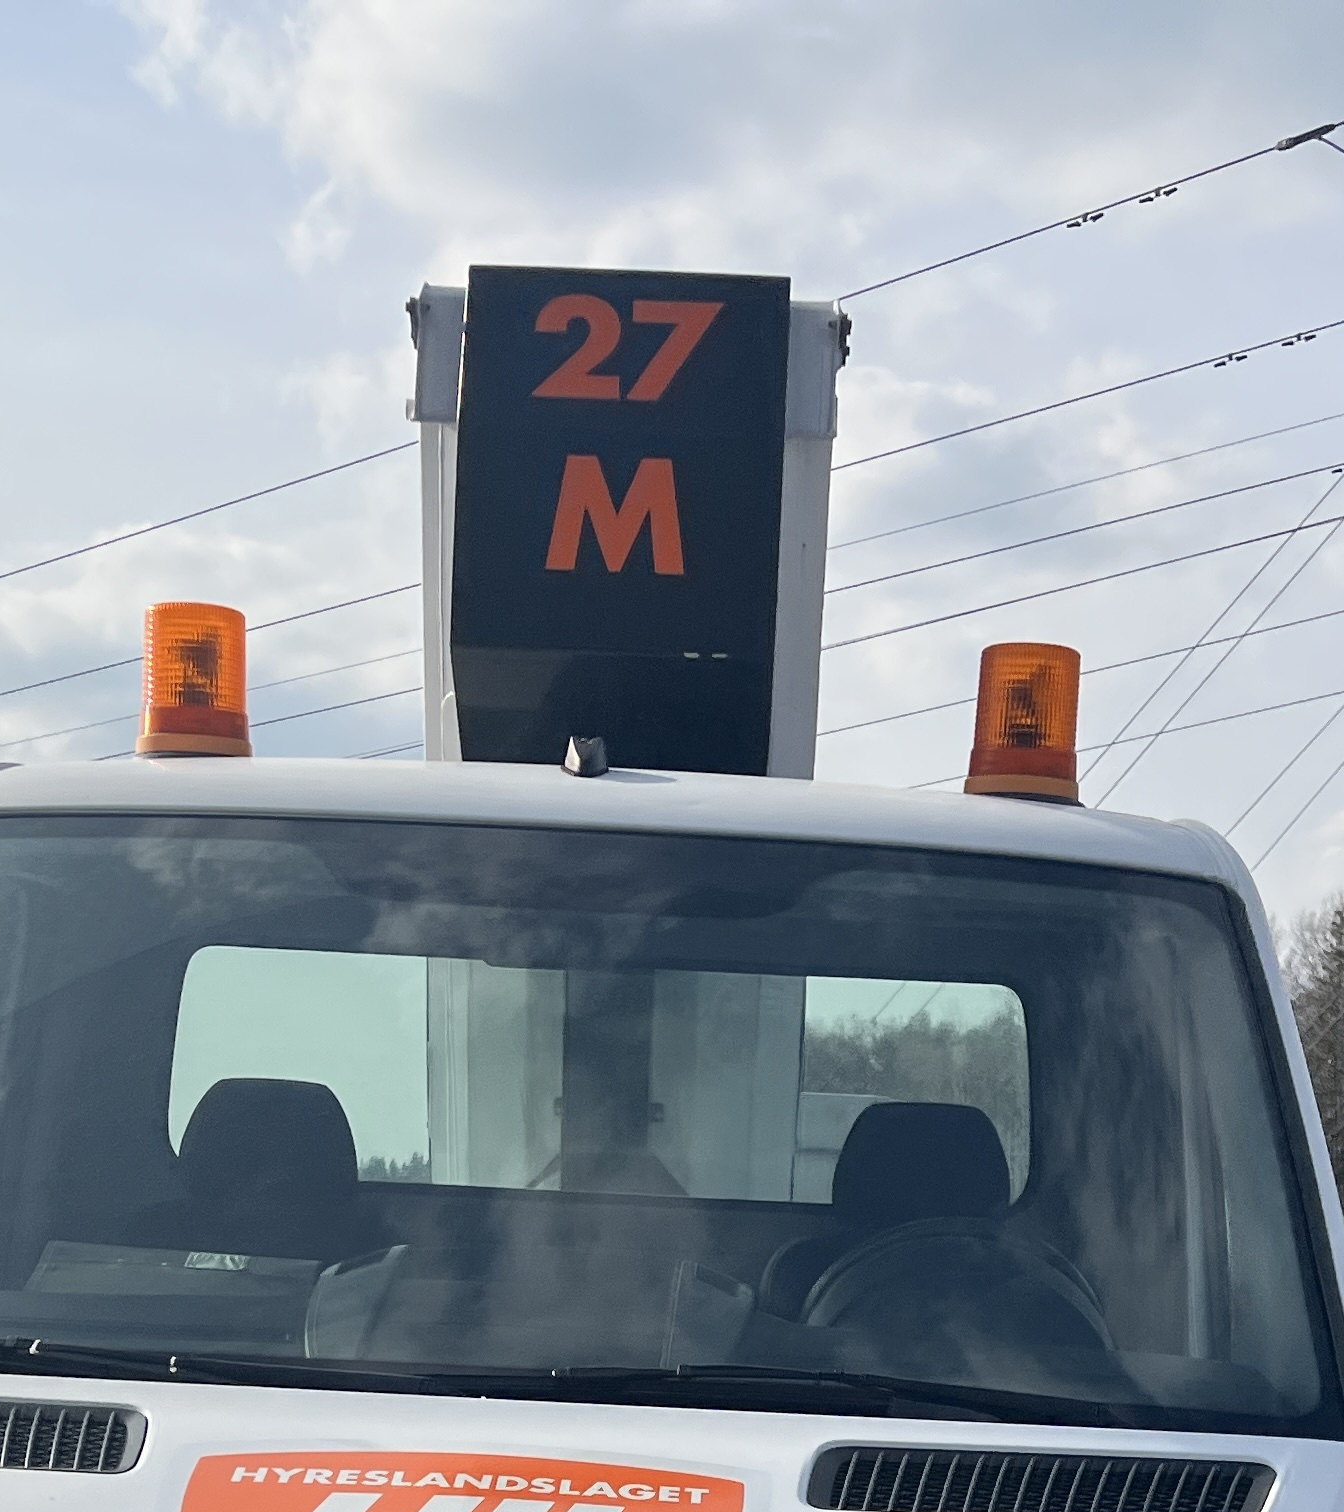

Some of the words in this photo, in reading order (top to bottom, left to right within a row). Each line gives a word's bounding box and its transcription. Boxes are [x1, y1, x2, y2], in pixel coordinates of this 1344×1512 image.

[532, 294, 724, 401] 27
[545, 453, 685, 575] M
[231, 1466, 710, 1504] HYRESLANDSLAGET
